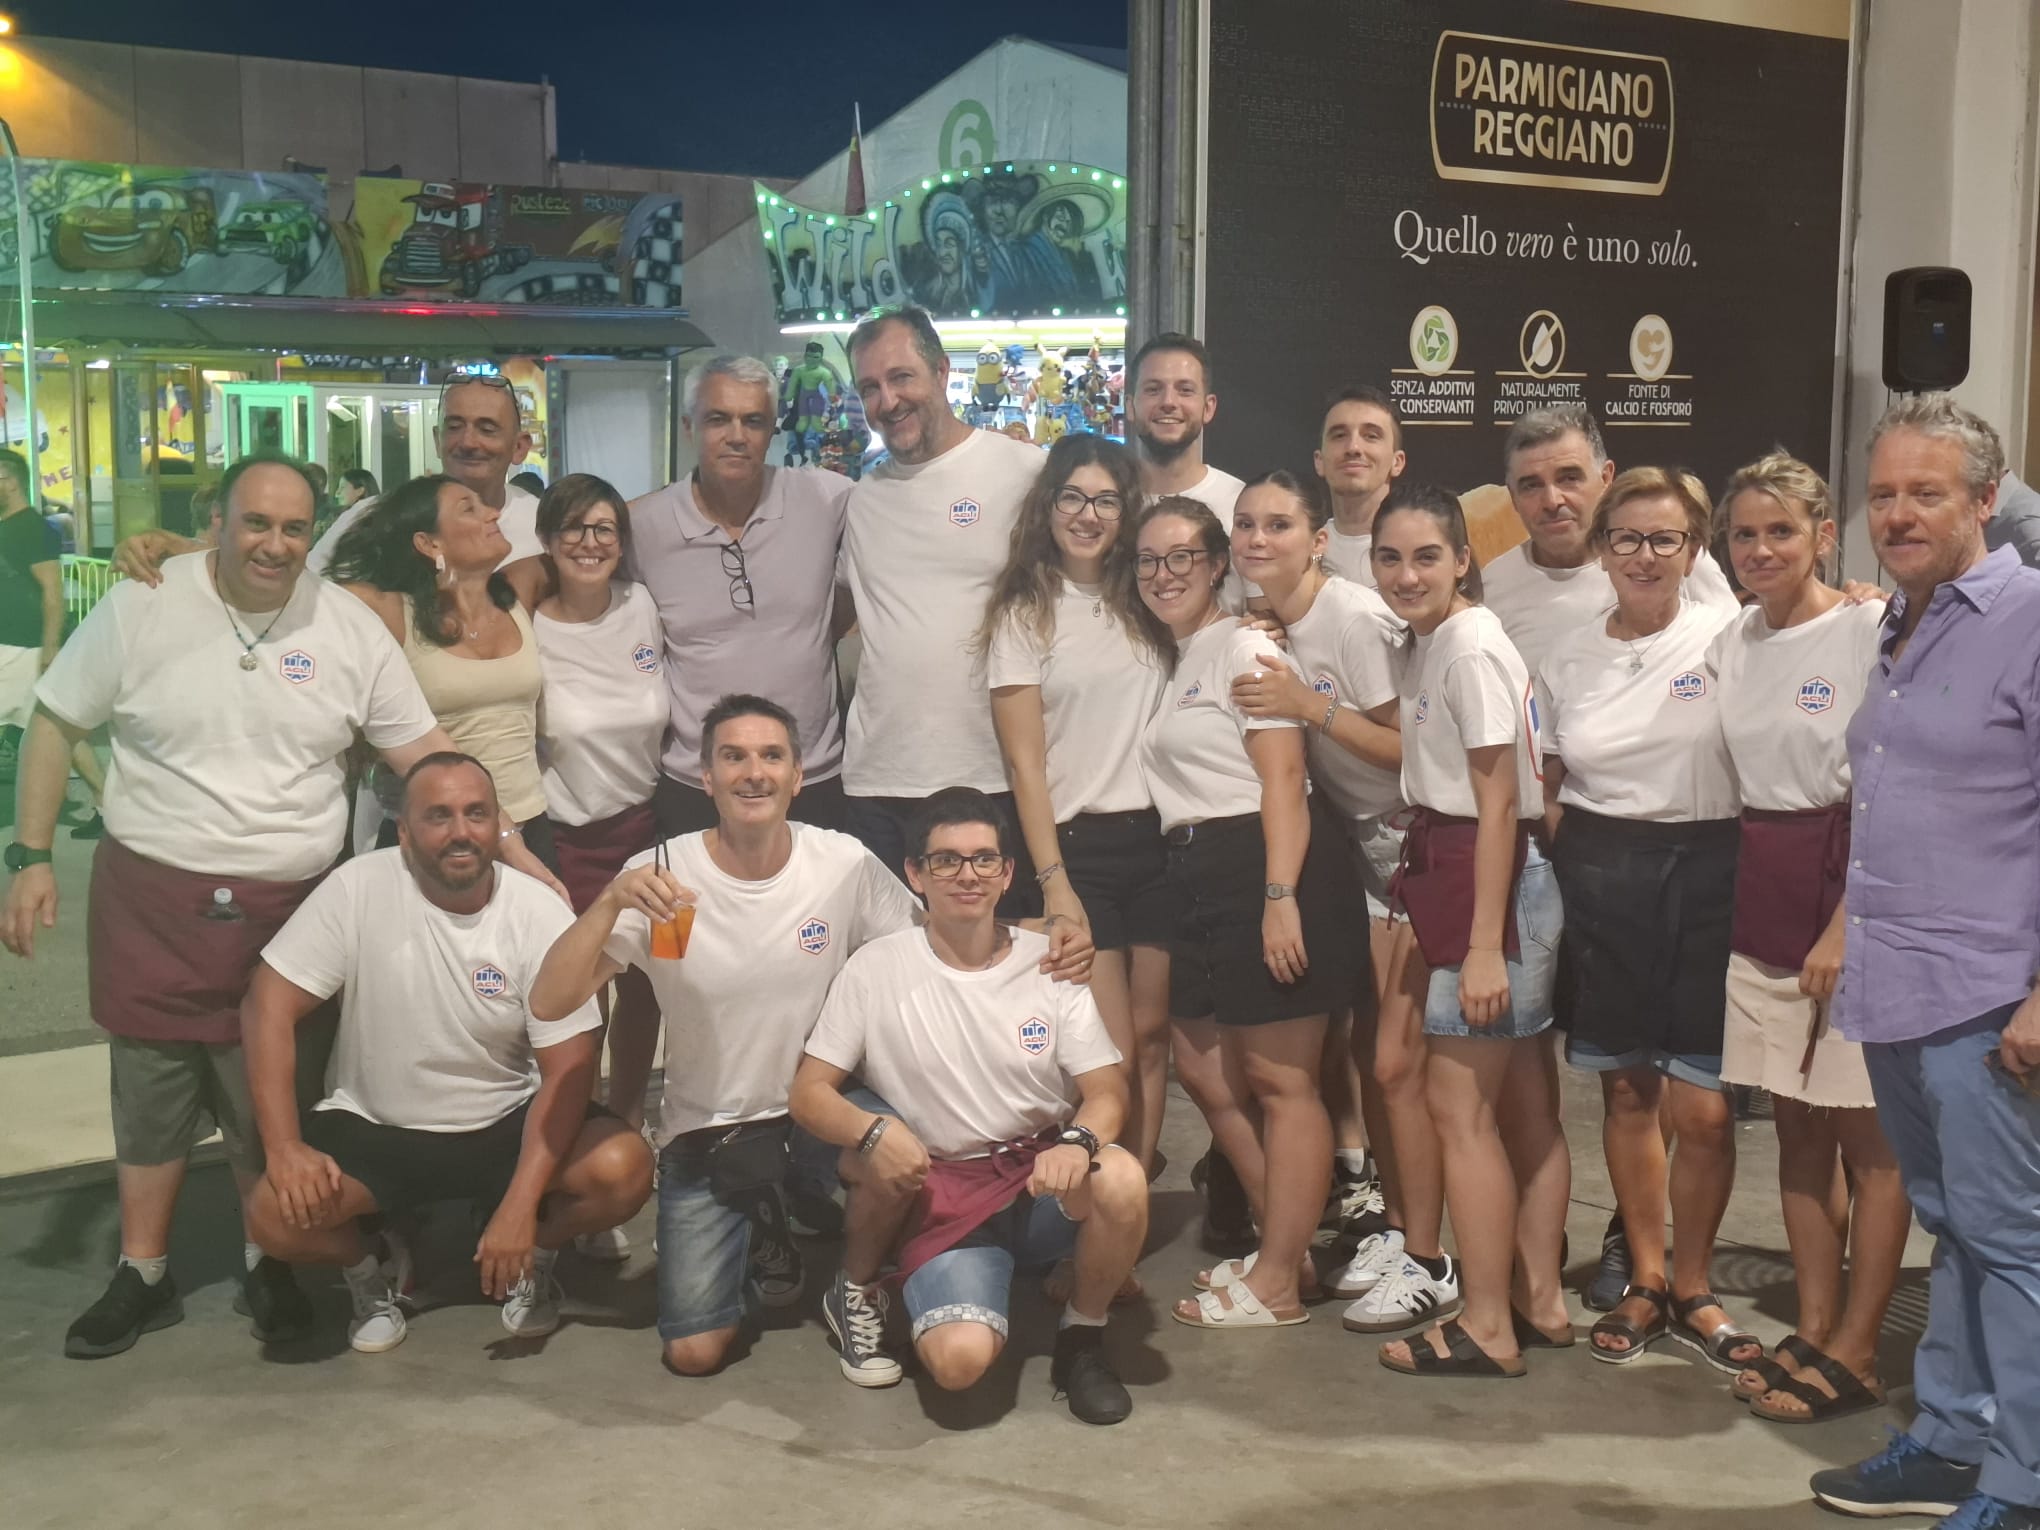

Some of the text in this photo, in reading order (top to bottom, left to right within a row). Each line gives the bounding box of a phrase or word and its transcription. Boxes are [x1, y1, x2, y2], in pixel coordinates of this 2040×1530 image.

[1454, 53, 1654, 118] PARMIGIANO
[1473, 108, 1634, 167] REGGIANO
[1393, 210, 1698, 267] Quello vero è uno solo.
[1391, 380, 1475, 396] SENZA ADDITIVI
[1501, 382, 1581, 397] NATURALMENTE
[1628, 384, 1671, 399] FONTE DI
[1400, 399, 1474, 414] CONSERVANTI
[1493, 400, 1524, 415] PRIVO
[1605, 401, 1639, 415] CALCIO
[1641, 402, 1648, 416] E
